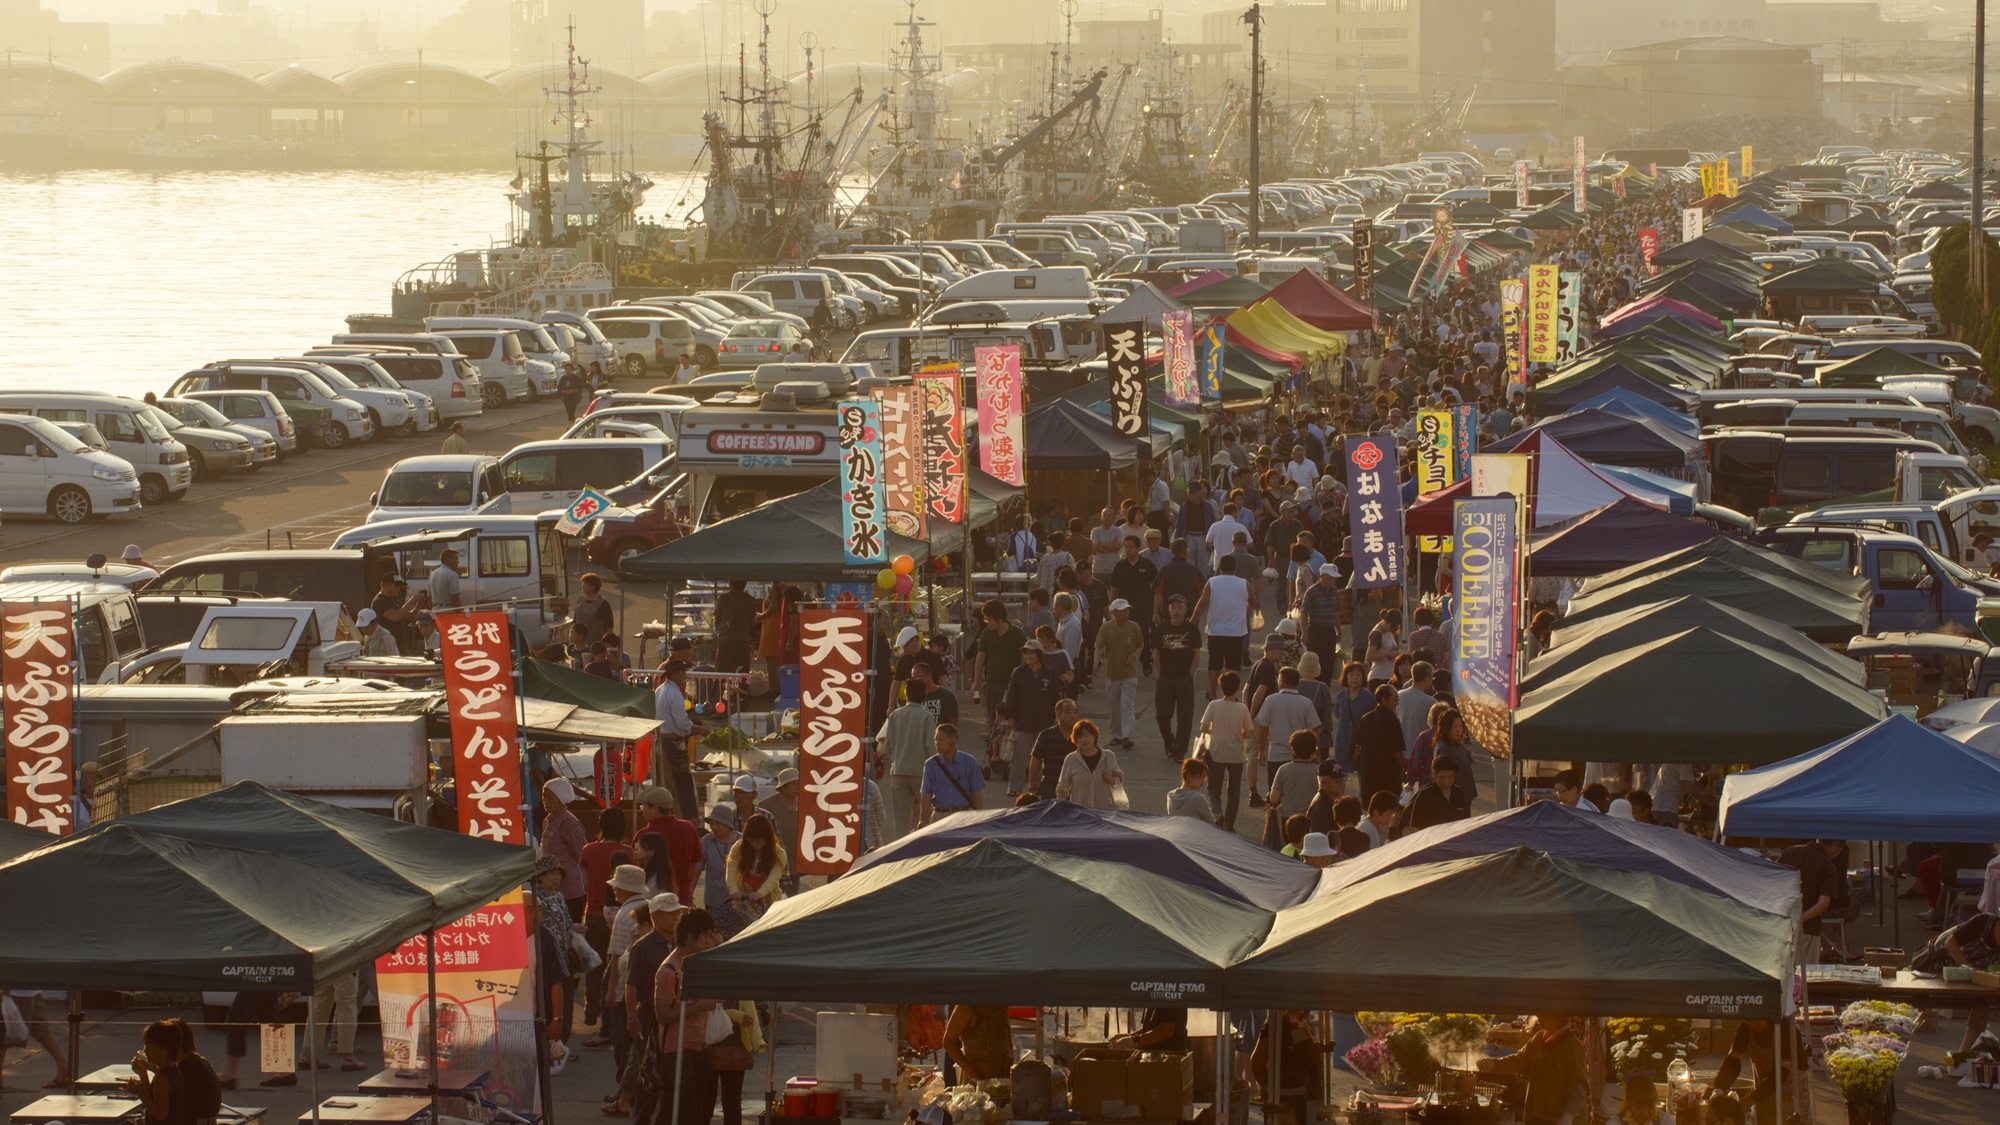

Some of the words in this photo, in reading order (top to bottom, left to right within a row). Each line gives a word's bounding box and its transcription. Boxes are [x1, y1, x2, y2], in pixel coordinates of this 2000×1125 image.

[1110, 330, 1142, 434] 天ぷら
[716, 434, 765, 449] COFFEE
[768, 435, 815, 450] STAND
[849, 448, 881, 558] かき氷
[447, 623, 500, 646] 名代
[4, 611, 72, 835] 天ぷらそば
[801, 617, 865, 863] 天ぷらそば
[222, 966, 267, 976] CAPTAIN
[268, 966, 296, 976] STAG
[1130, 981, 1176, 992] CAPTAIN
[1178, 983, 1206, 993] STAG
[1685, 995, 1733, 1005] CAPTAIN
[1735, 995, 1763, 1005] STAG
